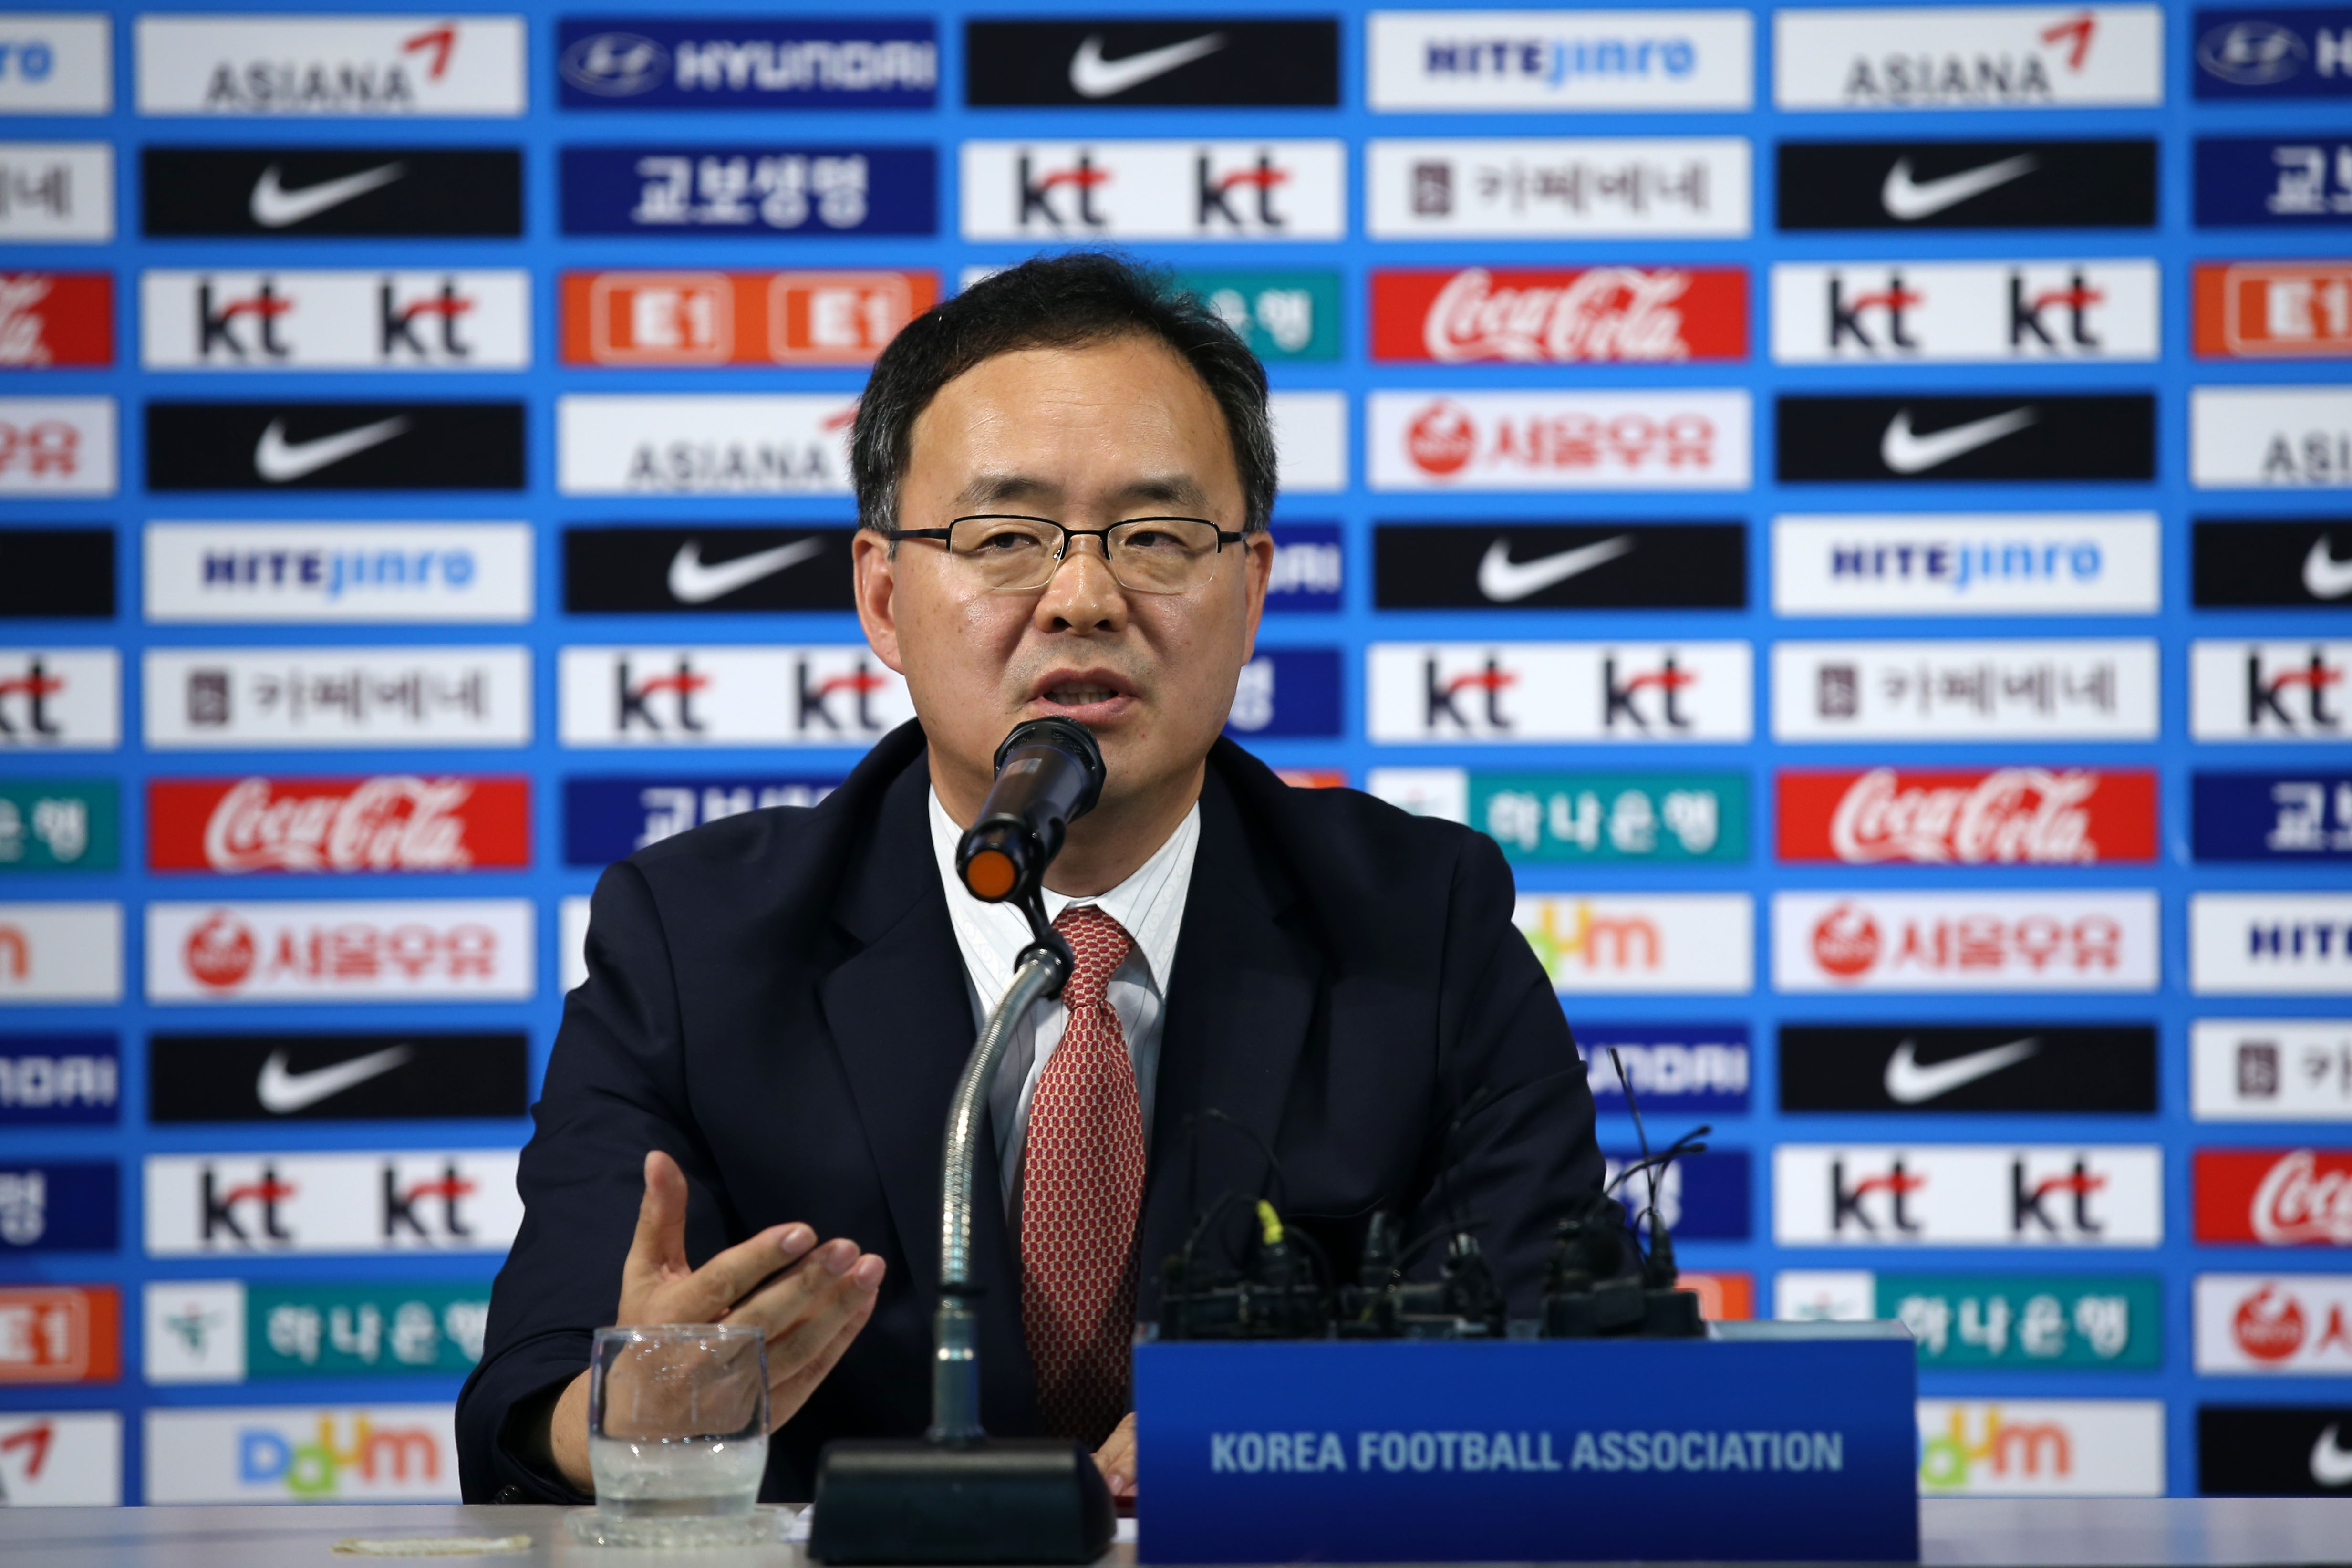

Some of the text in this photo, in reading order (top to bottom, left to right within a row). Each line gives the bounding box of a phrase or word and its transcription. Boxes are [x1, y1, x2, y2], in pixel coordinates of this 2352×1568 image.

[205, 63, 414, 106] ASIANA
[675, 41, 937, 89] HYUNDAI
[1845, 53, 2053, 99] ASIANA
[633, 156, 868, 227] 교보생명
[1017, 152, 1292, 227] kt kt
[197, 279, 476, 359] kt kt
[632, 291, 892, 347] E1 E1
[1828, 272, 2103, 350] kt kt
[2267, 281, 2351, 337] E1
[628, 444, 832, 482] ASIANA
[1487, 414, 1716, 472] 서울우유
[617, 654, 885, 732] kt kt
[1424, 655, 1695, 731] kt kt
[2247, 650, 2344, 732] kt
[1485, 790, 1719, 853] 하나은행
[266, 923, 496, 984] 서울우유
[1896, 914, 2124, 974] 서울우유
[200, 1164, 477, 1239] kt kt
[1831, 1158, 2105, 1235] kt kt
[1895, 1294, 2129, 1357] 하나은행
[238, 1413, 440, 1496] Daum
[1210, 1430, 1844, 1473] KOREA FOOTBALL ASSOCIATION
